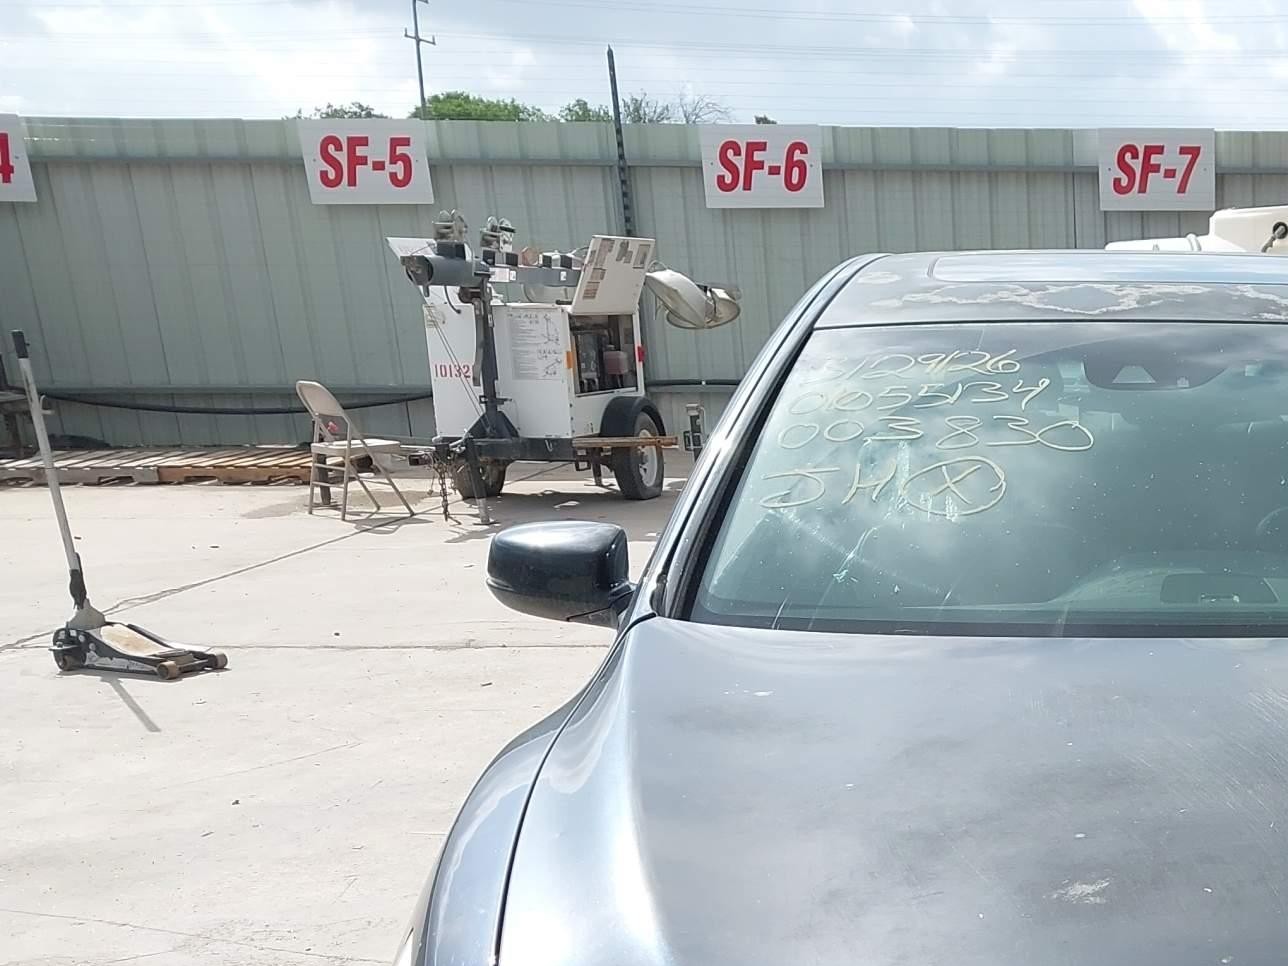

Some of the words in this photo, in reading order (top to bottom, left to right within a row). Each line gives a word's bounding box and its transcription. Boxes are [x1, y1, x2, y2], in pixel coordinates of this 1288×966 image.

[319, 135, 413, 188] SF-5
[716, 140, 809, 192] SF-6
[1112, 143, 1202, 195] SF-7
[777, 415, 1094, 452] 003830
